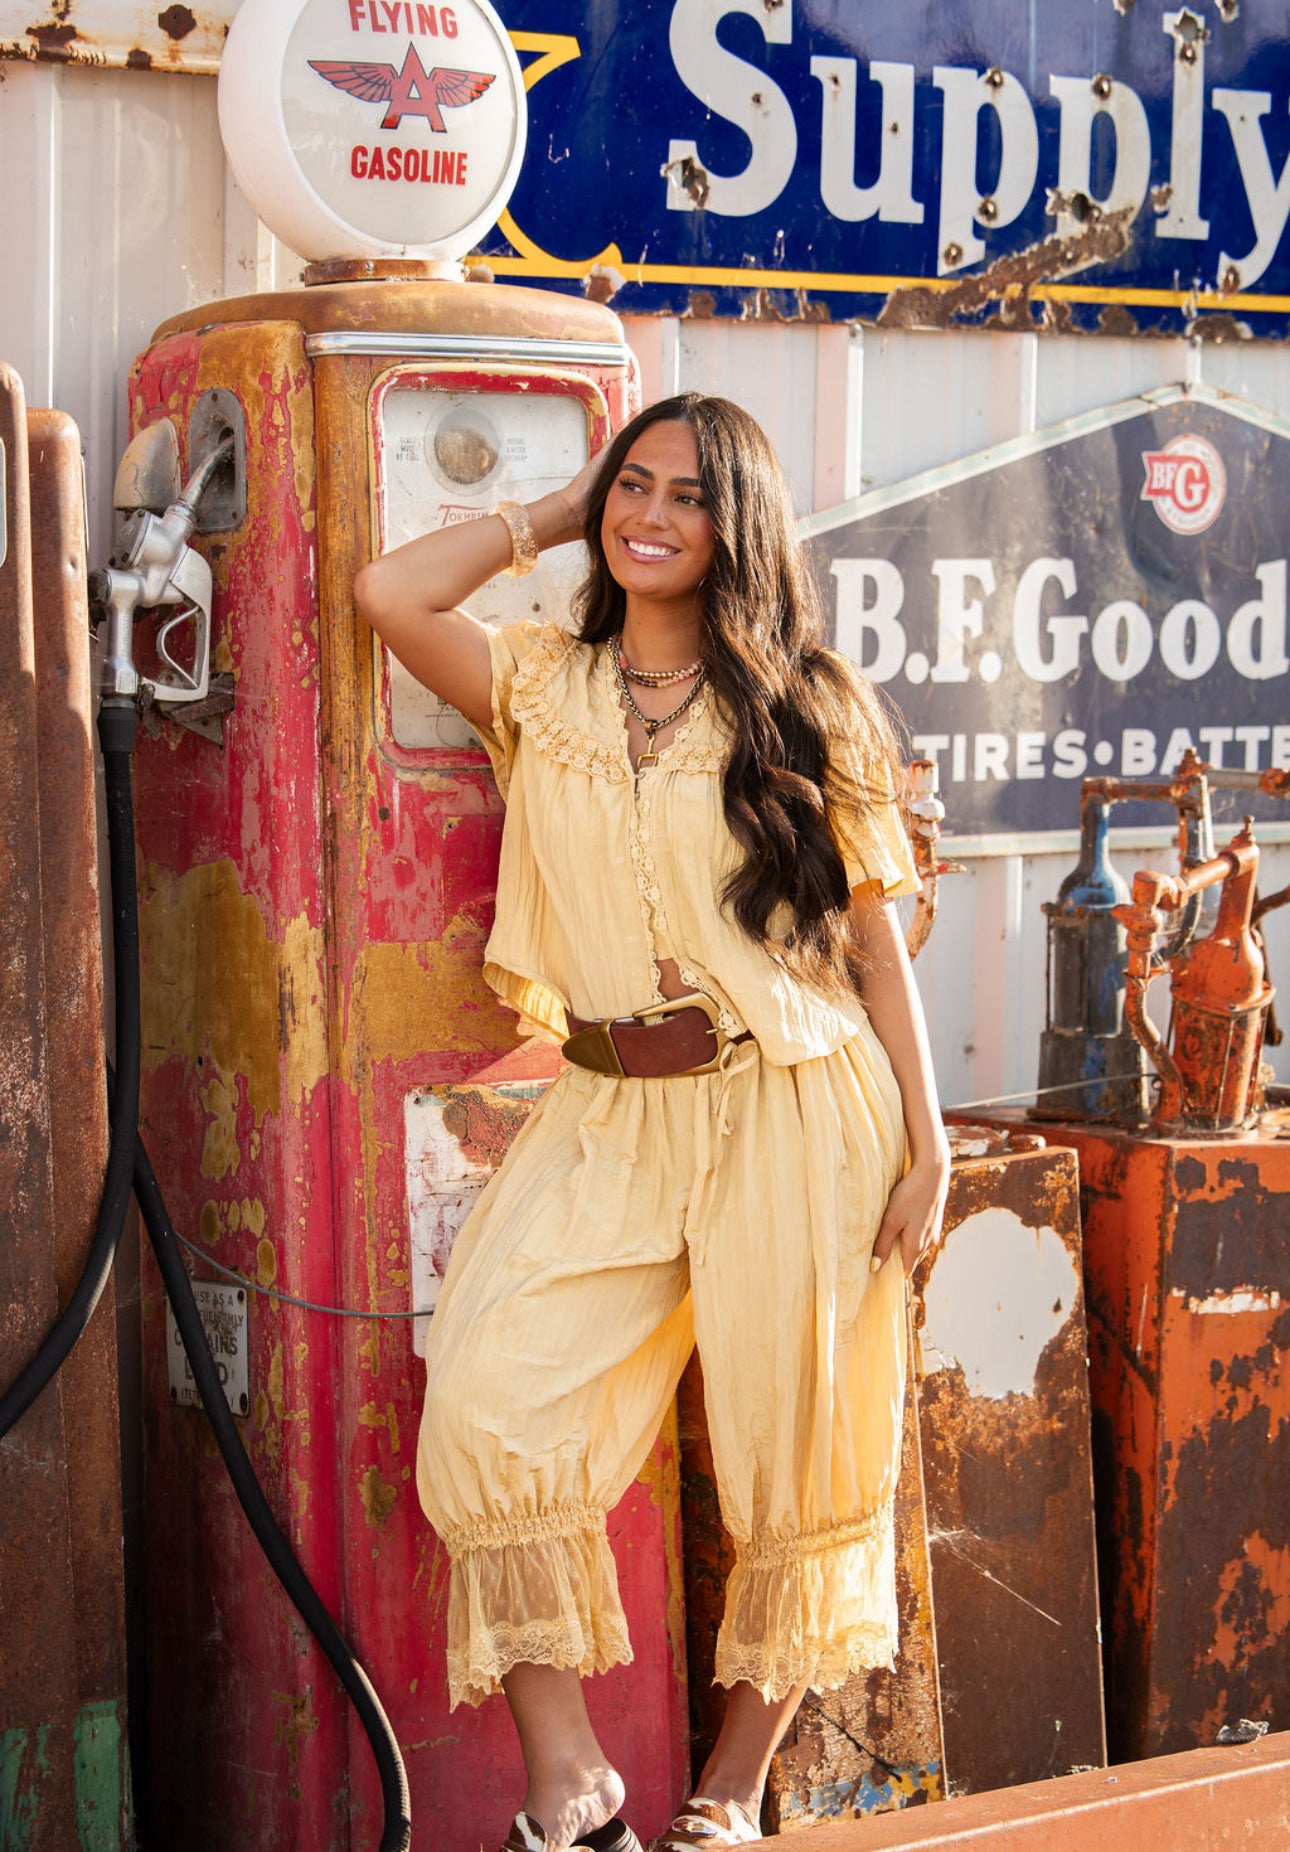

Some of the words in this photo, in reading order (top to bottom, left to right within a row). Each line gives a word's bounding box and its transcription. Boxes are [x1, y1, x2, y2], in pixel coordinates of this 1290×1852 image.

[348, 0, 458, 39] FLYING
[350, 145, 467, 186] GASOLINE
[664, 0, 1290, 292] Supply
[913, 729, 1088, 782] TIRES
